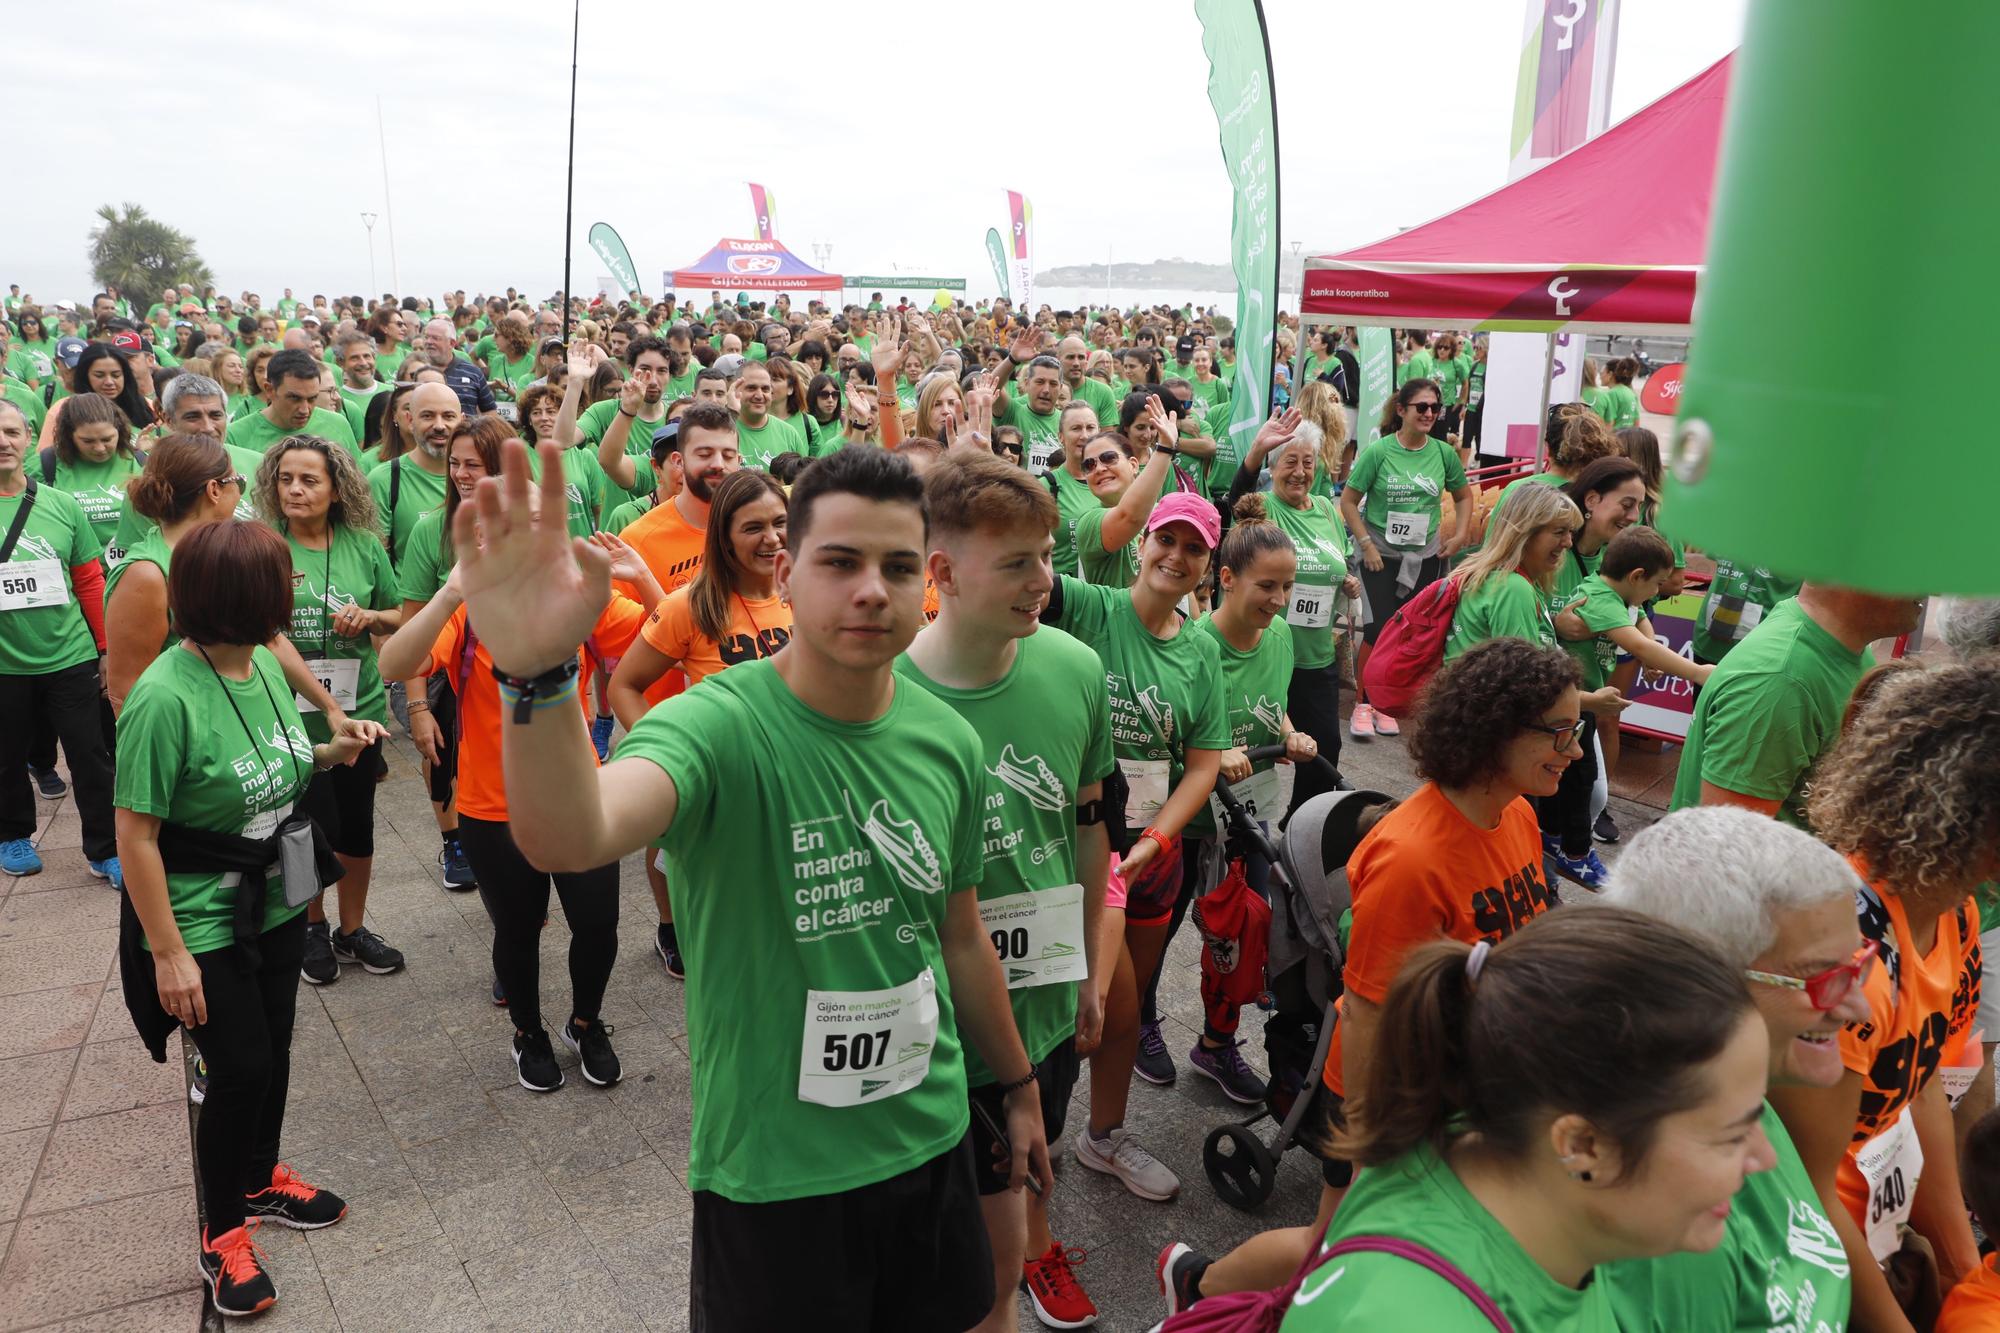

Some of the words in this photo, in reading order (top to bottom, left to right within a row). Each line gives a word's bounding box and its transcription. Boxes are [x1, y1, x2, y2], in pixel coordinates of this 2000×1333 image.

[712, 275, 753, 287] GIJÓN
[756, 279, 808, 288] ATLETISMO
[1310, 288, 1334, 297] banka
[1336, 288, 1389, 298] kooperatiboa
[80, 504, 111, 512] ontra
[92, 511, 121, 520] cánce
[1391, 523, 1410, 536] 572
[1303, 563, 1331, 571] cáncer
[4, 577, 37, 595] 550
[1295, 599, 1320, 614] 601
[1551, 599, 1564, 608] En
[233, 760, 257, 778] En
[792, 828, 824, 852] En
[794, 846, 872, 879] marcha
[795, 876, 864, 905] contra
[1006, 900, 1037, 910] marcha
[795, 909, 819, 932] el
[822, 897, 894, 926] cáncer
[998, 912, 1007, 920] el
[1009, 908, 1038, 919] cáncer
[817, 1001, 846, 1013] Gijón
[848, 1004, 863, 1012] en
[865, 998, 902, 1010] marcha
[816, 1013, 852, 1022] contra
[855, 1012, 866, 1021] el
[867, 1008, 901, 1021] cáncer
[823, 1029, 891, 1071] 507
[1871, 1166, 1906, 1225] 540
[1766, 1285, 1793, 1323] En
